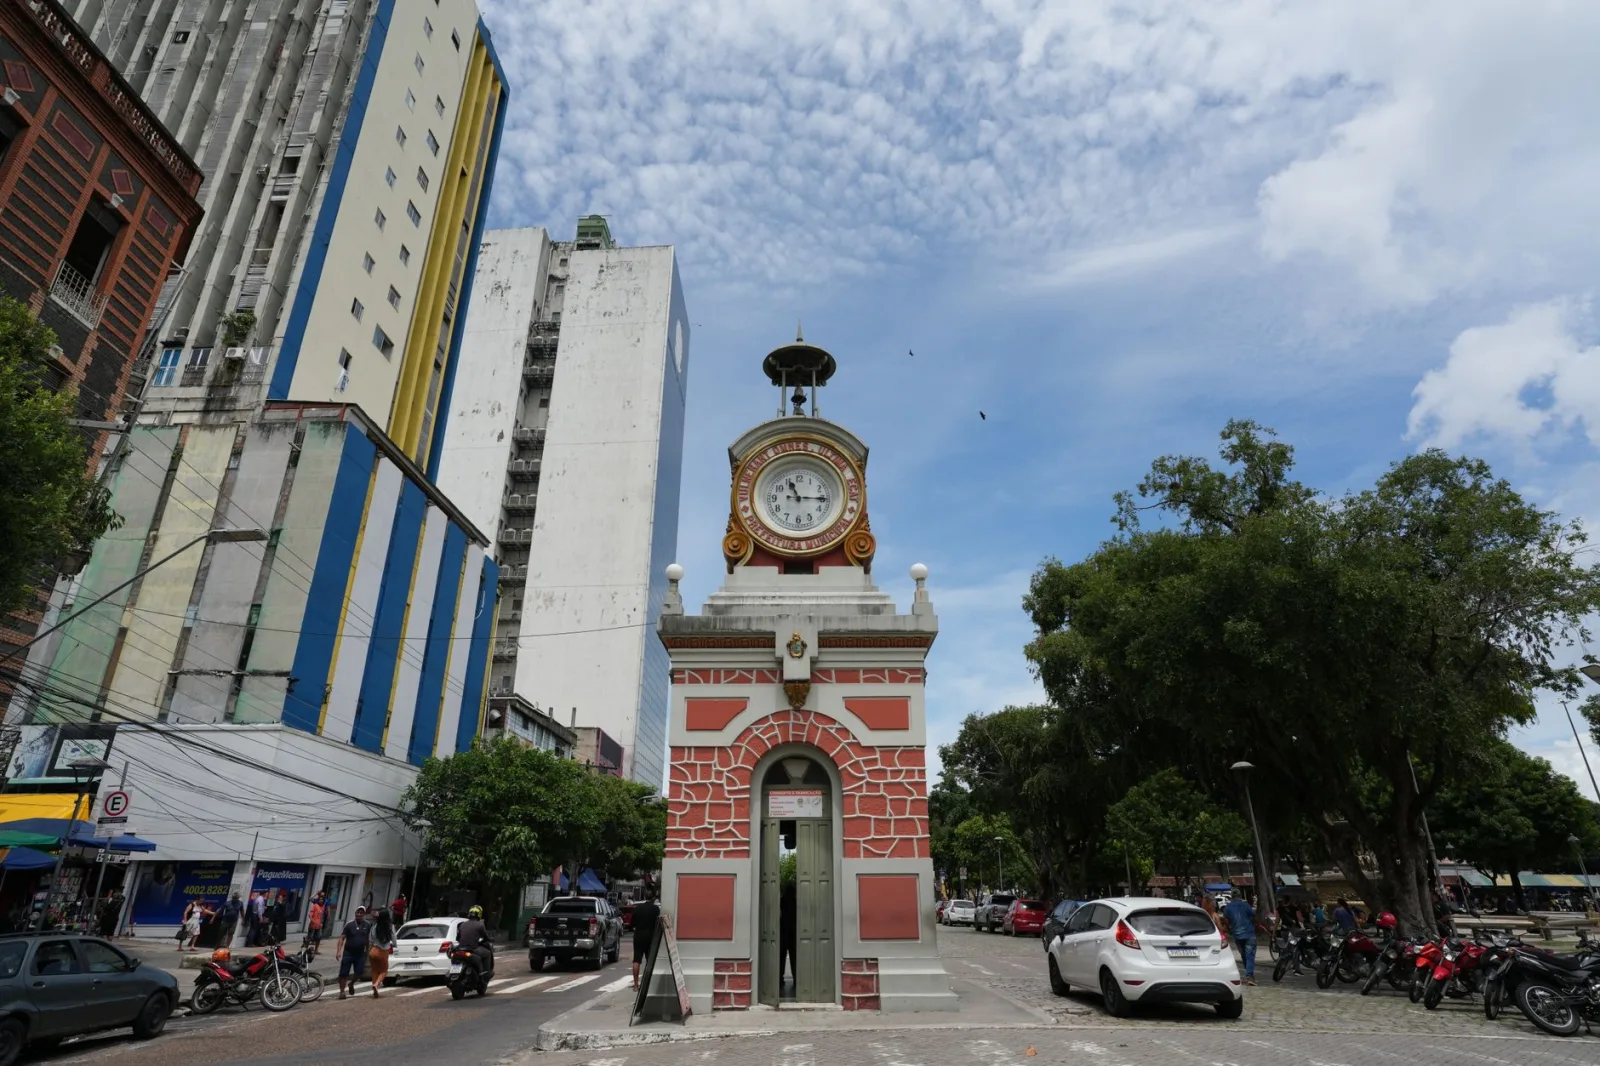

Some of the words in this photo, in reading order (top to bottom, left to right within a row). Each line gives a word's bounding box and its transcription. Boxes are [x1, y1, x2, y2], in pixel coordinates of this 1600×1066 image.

[796, 475, 804, 483] 12
[809, 477, 812, 485] 1
[817, 485, 822, 493] 2
[771, 494, 777, 502] 9
[775, 504, 781, 512] 8
[784, 513, 790, 521] 7
[795, 515, 802, 524] 6
[807, 513, 813, 521] 5
[746, 515, 802, 549] PREFEITURA
[806, 518, 853, 549] MUNICIPAL
[111, 796, 122, 811] E
[256, 869, 305, 881] PagueMenos
